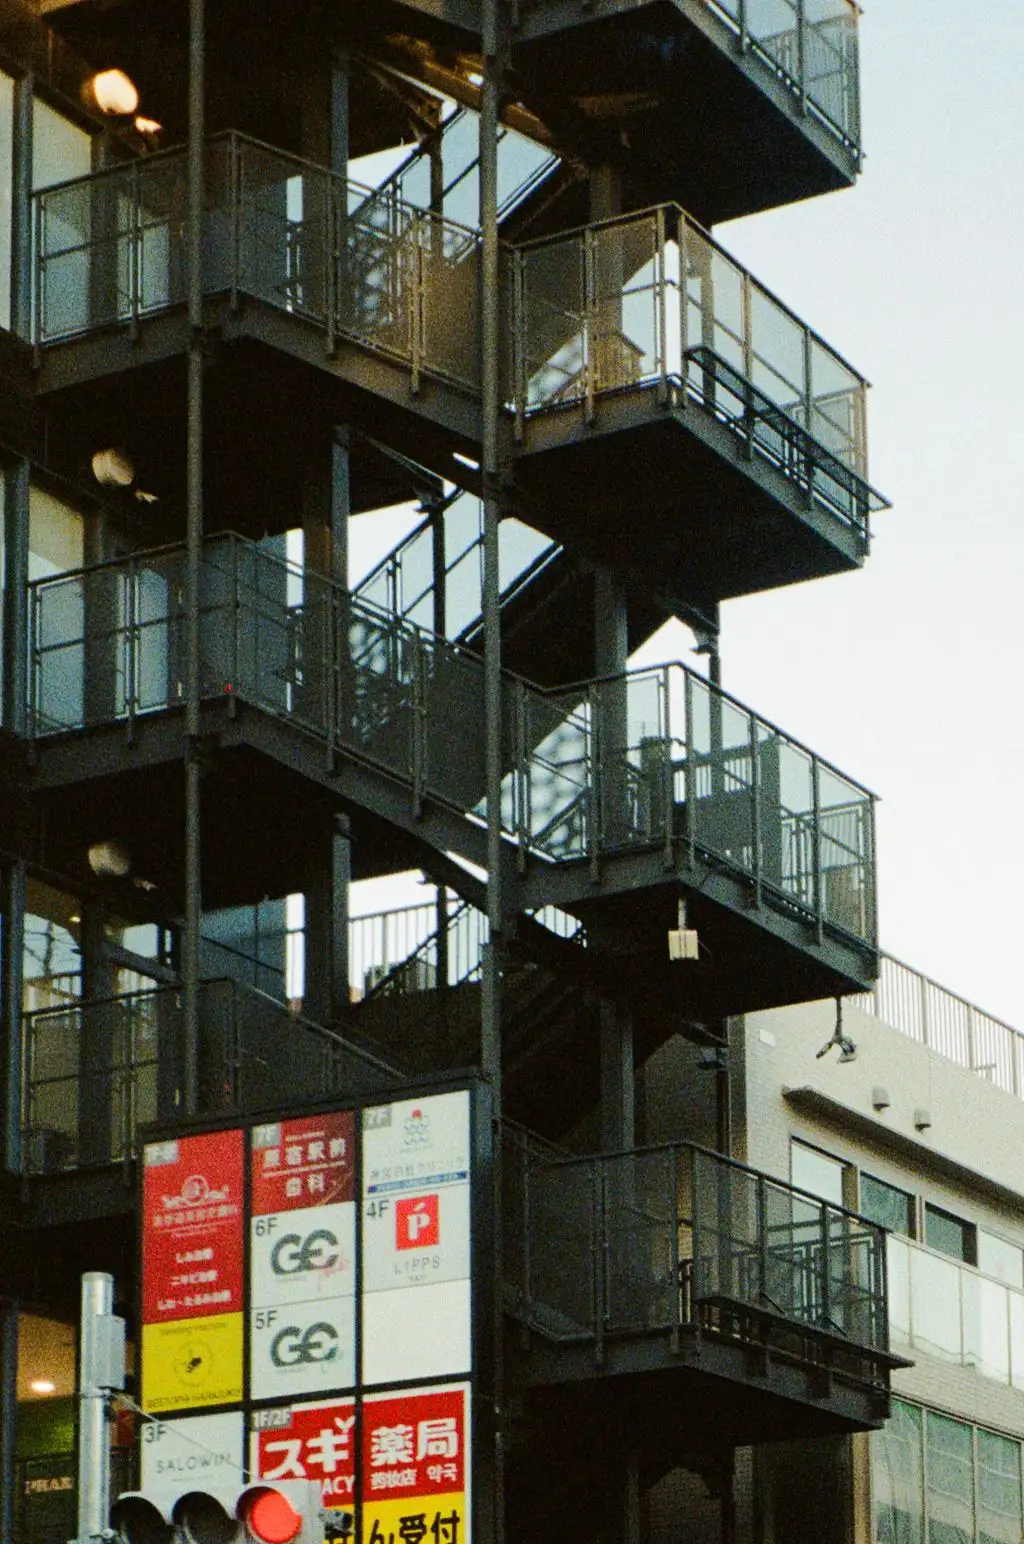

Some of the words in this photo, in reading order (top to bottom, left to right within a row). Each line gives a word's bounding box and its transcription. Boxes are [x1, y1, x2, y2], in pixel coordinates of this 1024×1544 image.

[367, 1200, 389, 1218] 4F
[255, 1218, 277, 1237] 6F
[255, 1312, 278, 1330] 5F
[145, 1424, 167, 1443] 3F
